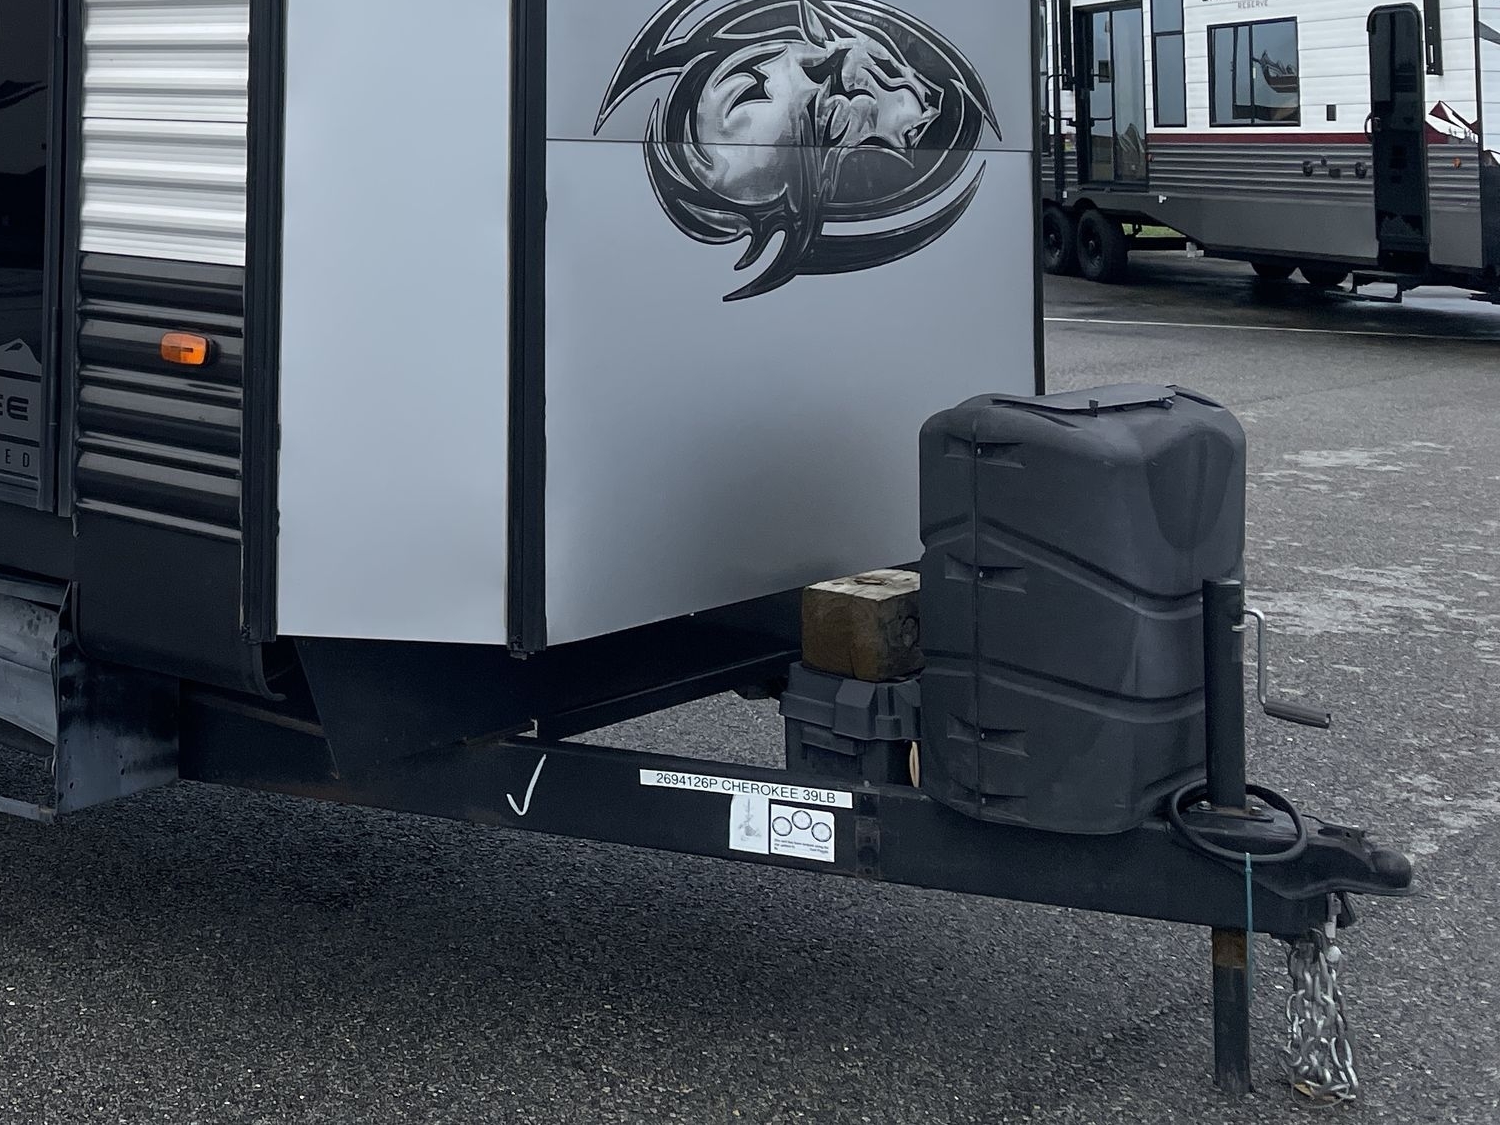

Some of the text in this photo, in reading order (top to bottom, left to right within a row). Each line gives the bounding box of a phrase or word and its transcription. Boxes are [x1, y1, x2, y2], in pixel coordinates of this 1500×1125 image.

[656, 772, 836, 804] 2694126P CHEROKEE 39LB
